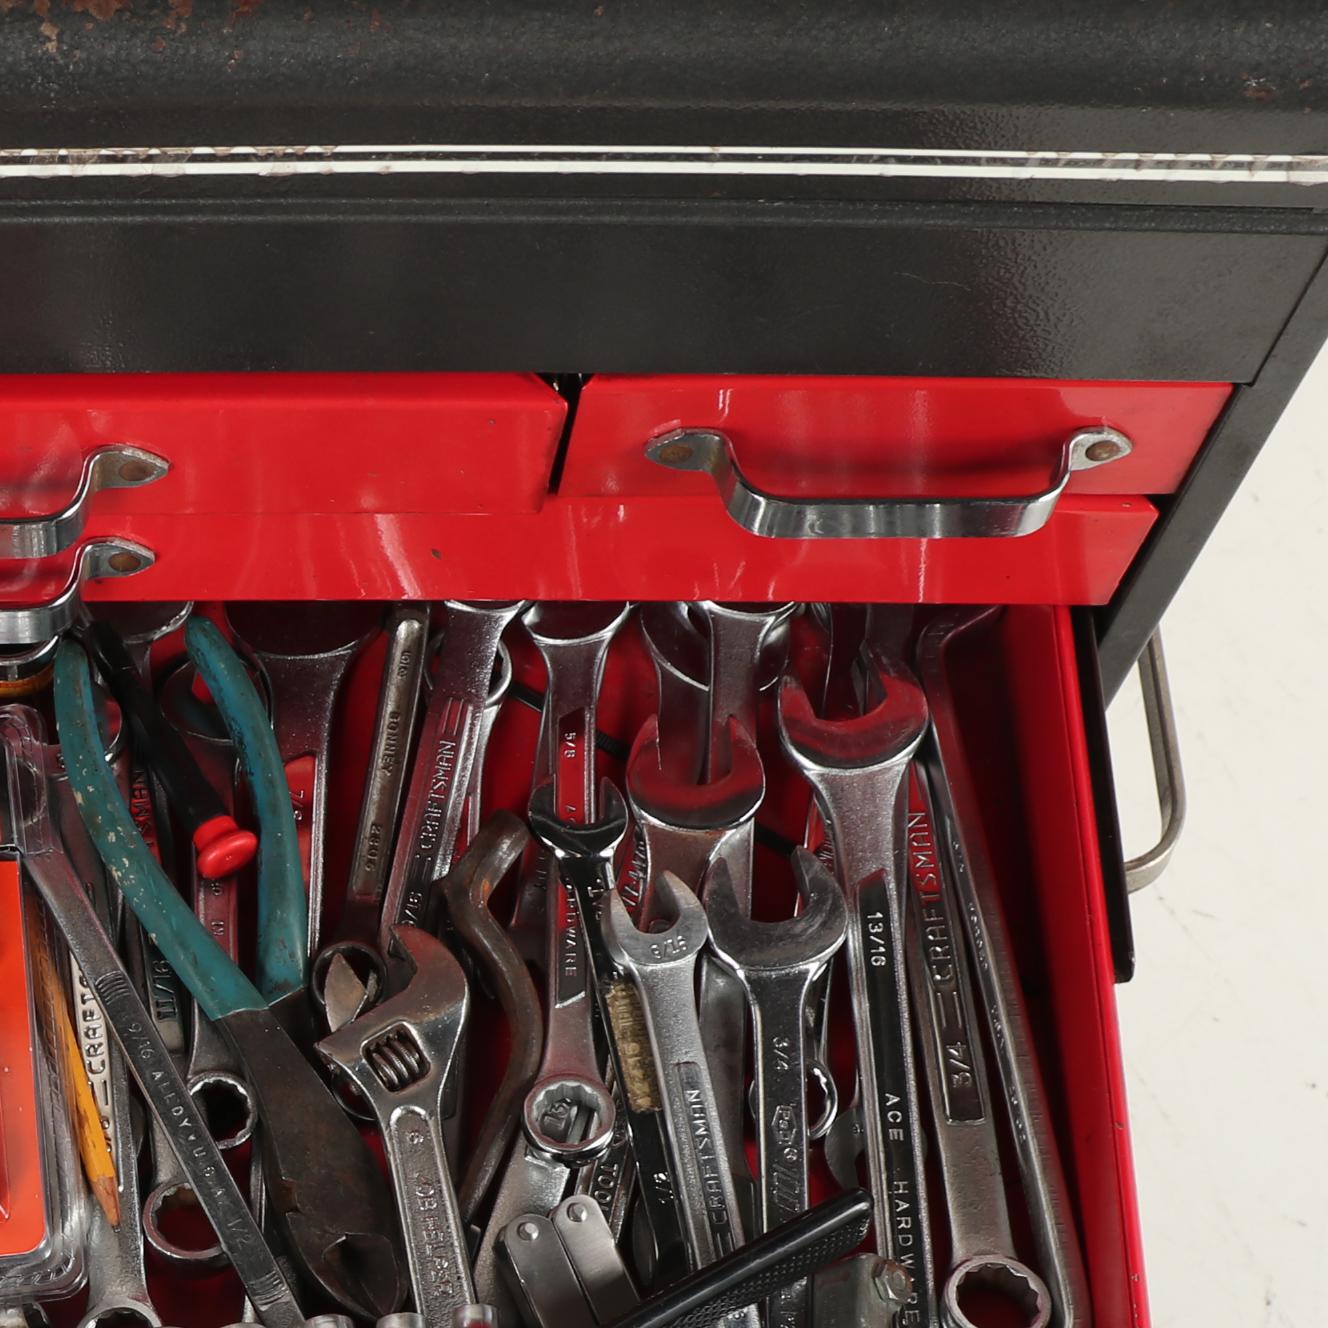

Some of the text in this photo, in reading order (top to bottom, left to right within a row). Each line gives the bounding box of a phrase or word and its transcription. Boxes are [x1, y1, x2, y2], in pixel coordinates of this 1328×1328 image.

[866, 911, 886, 967] 13/16
[908, 811, 953, 983] CRAFTSMAN
[948, 1041, 973, 1089] 3/4
[884, 1093, 921, 1327] ACE HARDWRE
